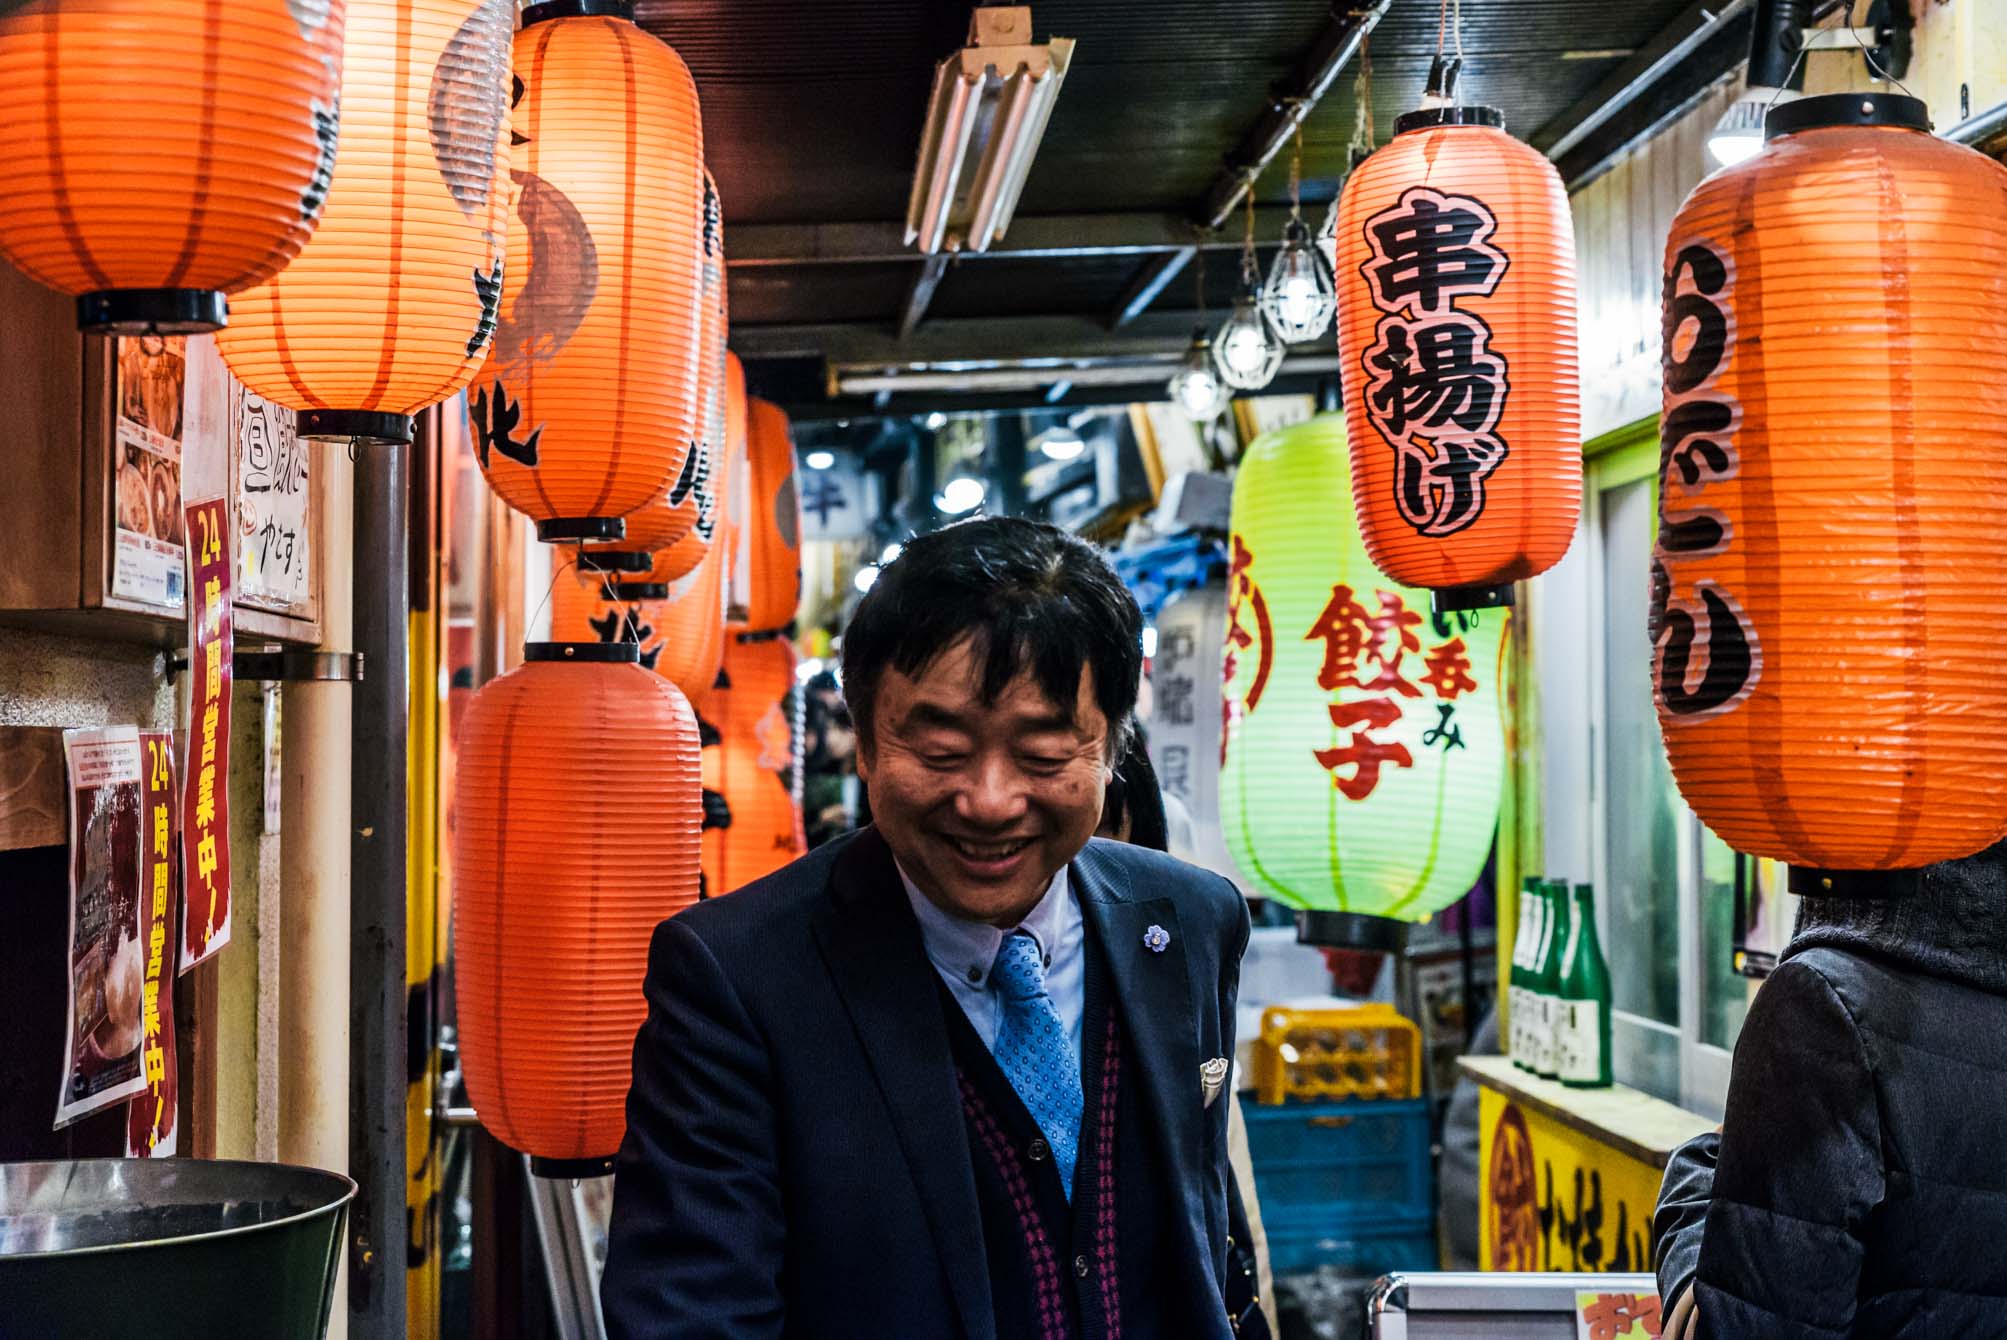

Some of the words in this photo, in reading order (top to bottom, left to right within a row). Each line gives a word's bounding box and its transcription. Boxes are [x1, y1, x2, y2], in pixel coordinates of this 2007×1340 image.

[1360, 186, 1511, 537] 串揚げ
[1305, 582, 1424, 803] 餃子
